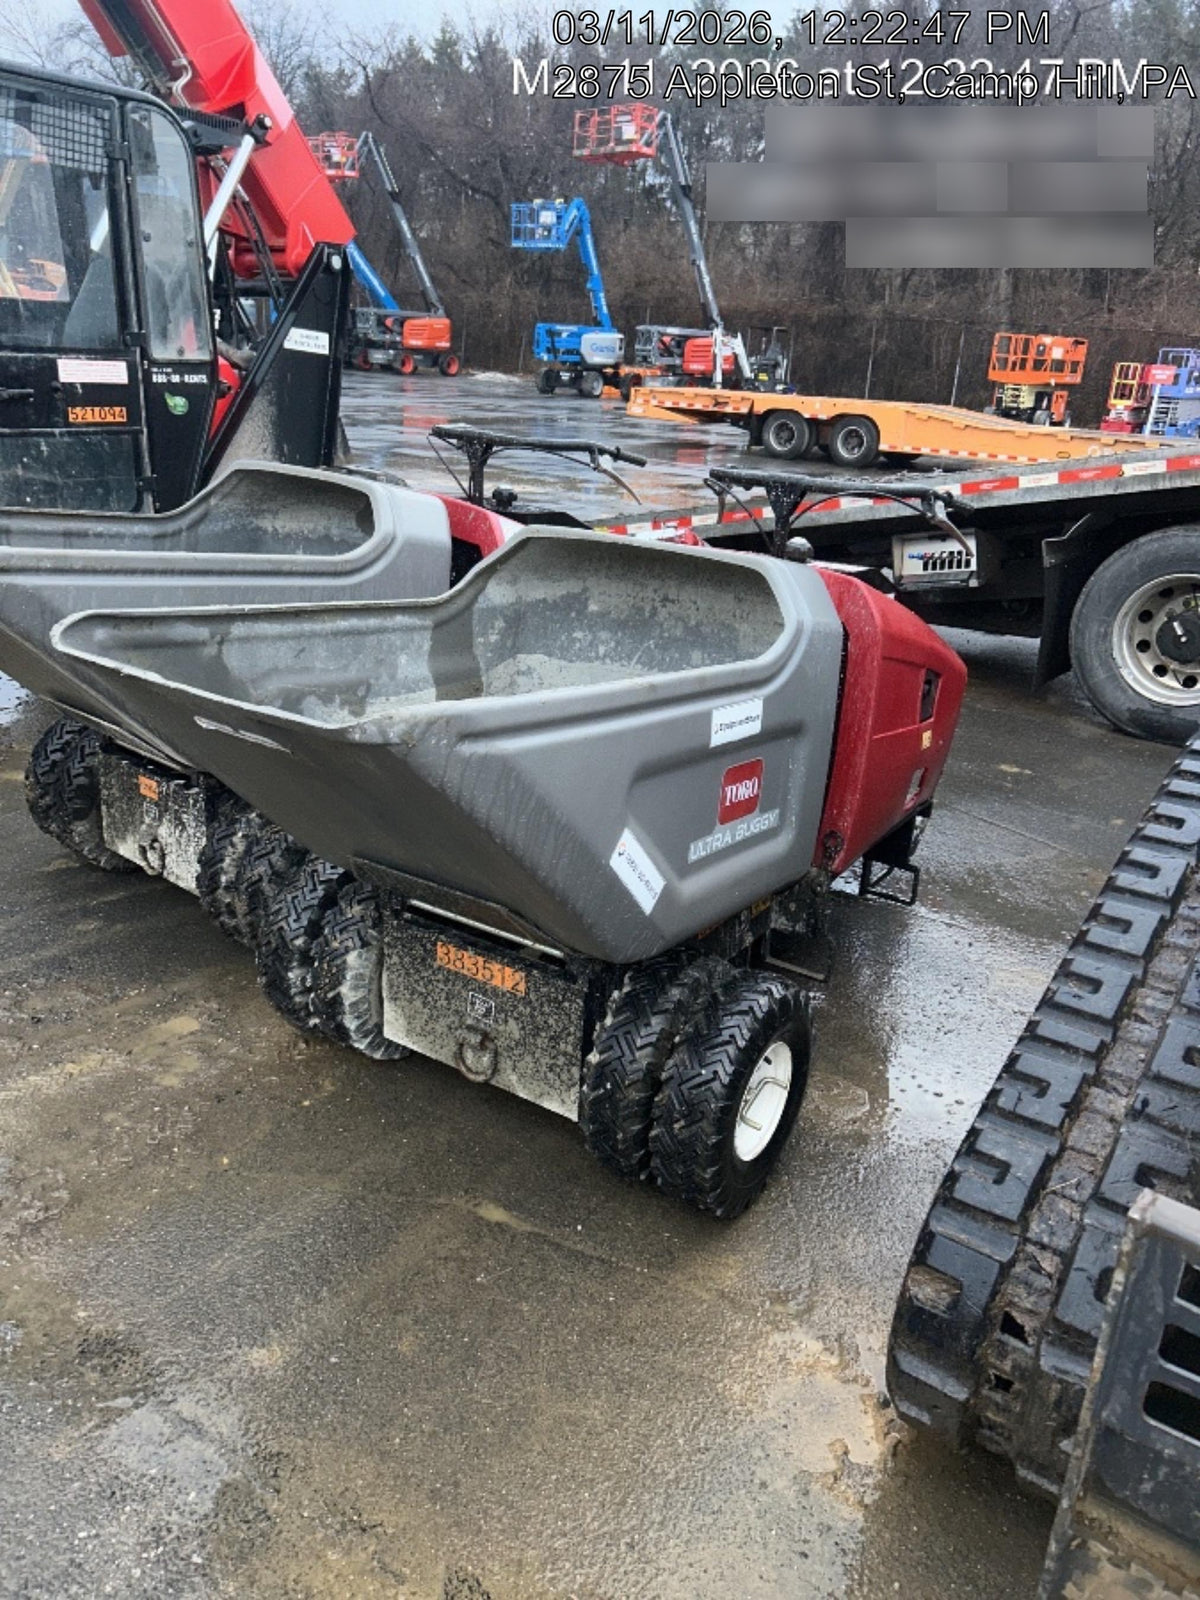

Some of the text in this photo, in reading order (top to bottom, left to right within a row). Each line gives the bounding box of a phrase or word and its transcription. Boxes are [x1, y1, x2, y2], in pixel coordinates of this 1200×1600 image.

[70, 407, 126, 421] 521094
[724, 776, 759, 807] TORO
[688, 811, 778, 861] ULTRA BUGGY
[438, 943, 525, 994] 383512
